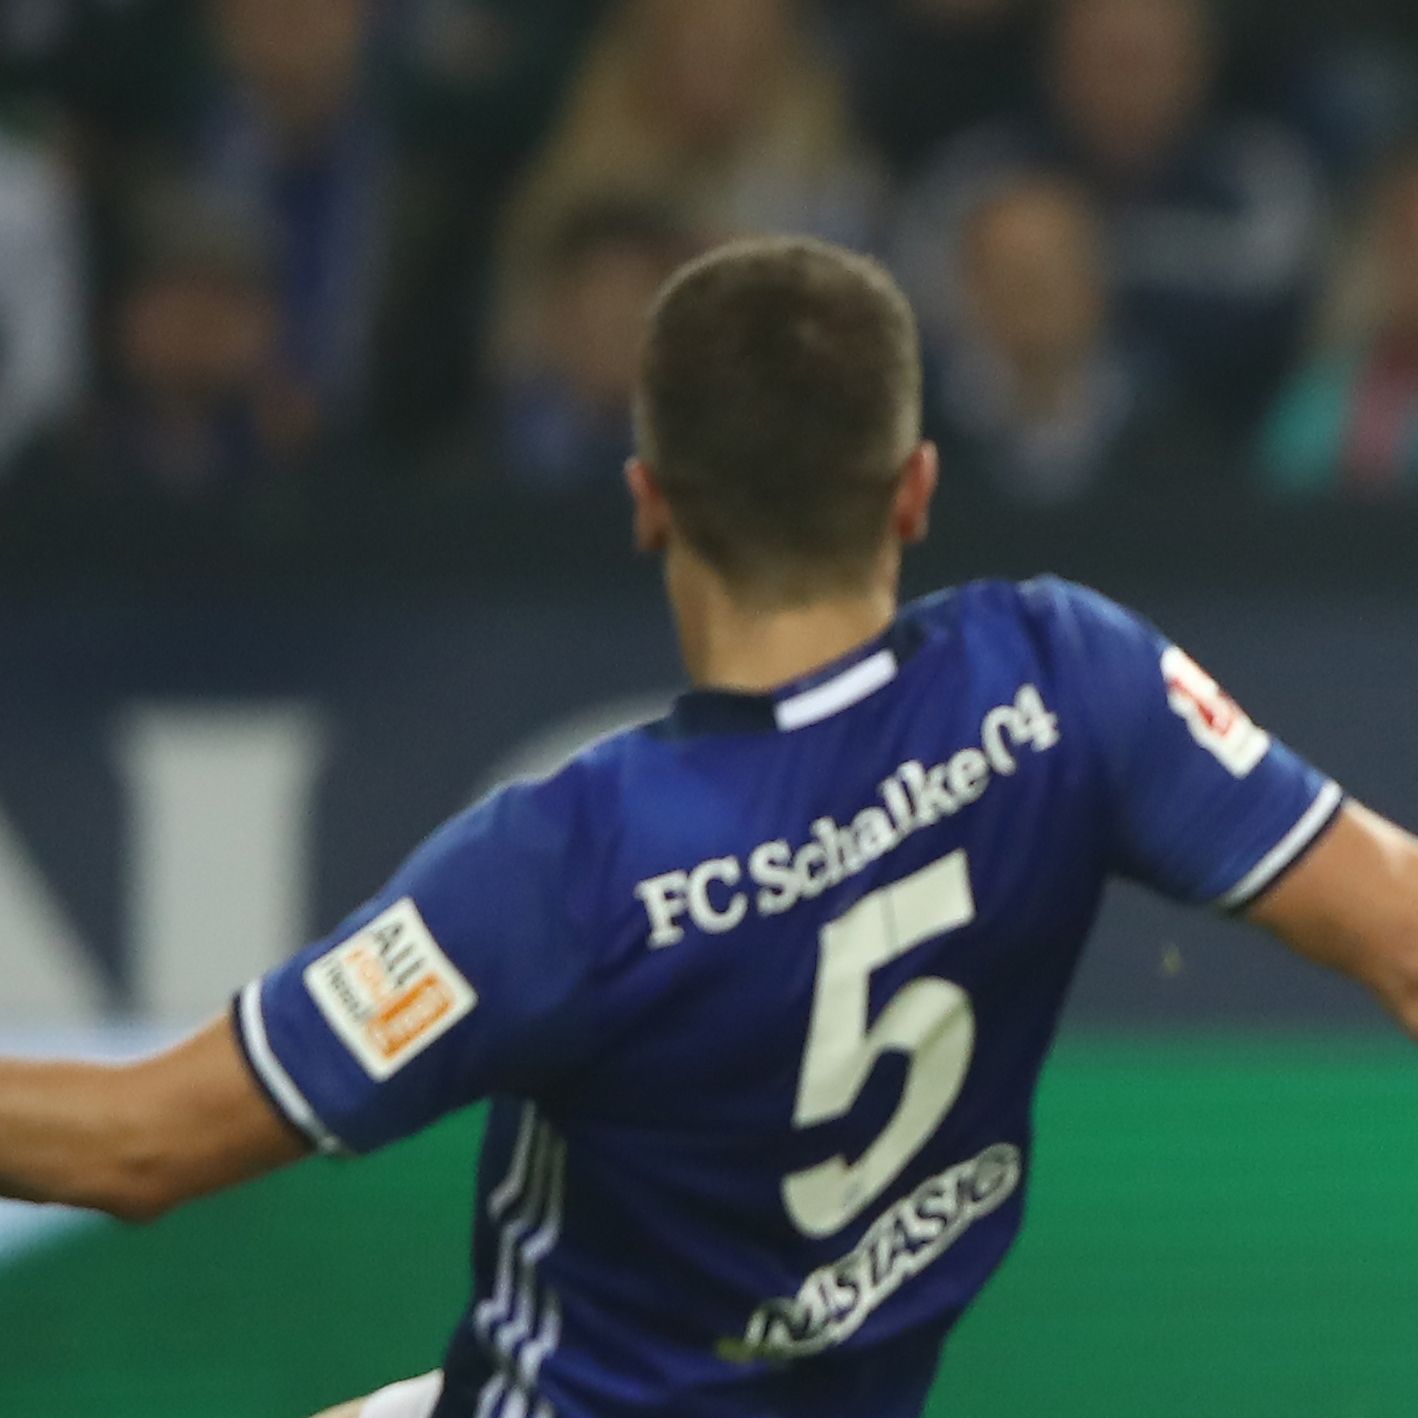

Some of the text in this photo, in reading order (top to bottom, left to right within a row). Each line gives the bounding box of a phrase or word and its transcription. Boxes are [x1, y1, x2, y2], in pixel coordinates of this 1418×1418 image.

[634, 855, 748, 949] FC
[748, 747, 990, 918] Schalke
[782, 849, 975, 1236] 5
